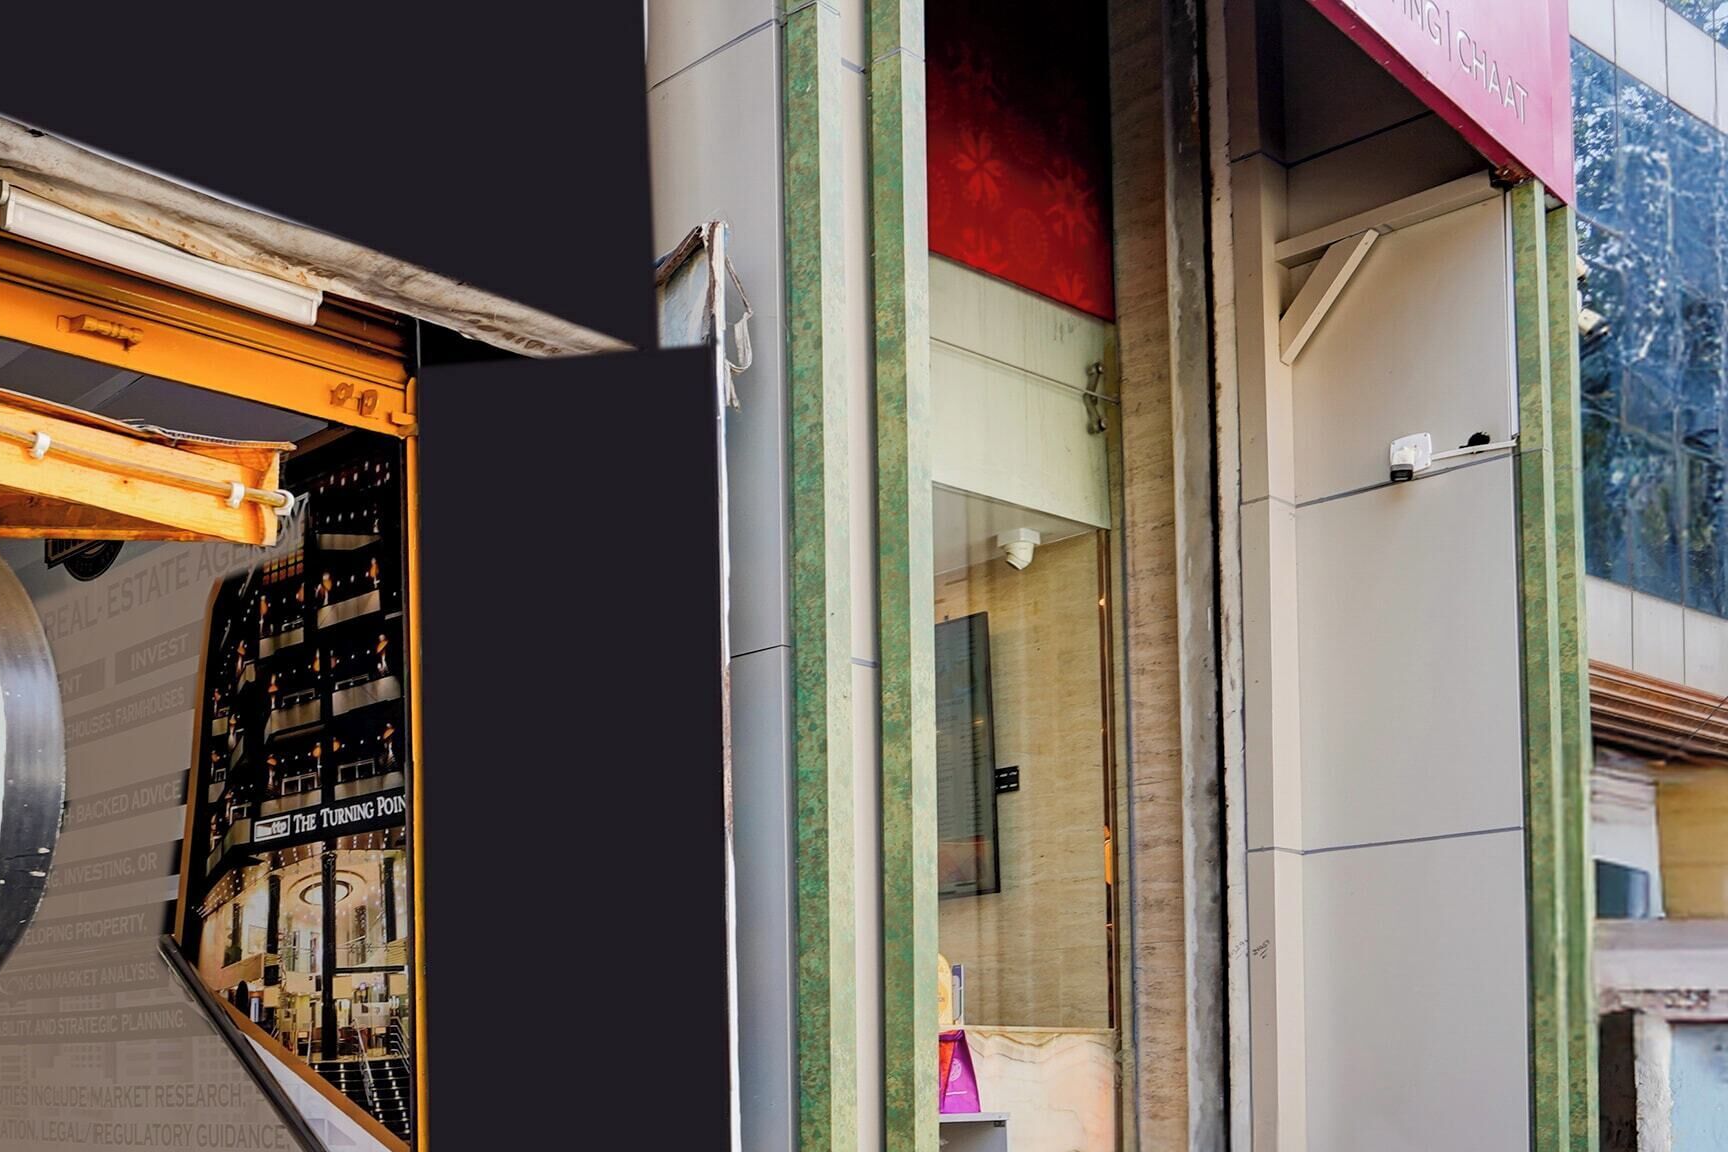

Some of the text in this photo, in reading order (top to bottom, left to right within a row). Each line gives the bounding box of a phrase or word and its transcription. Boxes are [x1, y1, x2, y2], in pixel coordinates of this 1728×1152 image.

[1456, 29, 1529, 125] CHAAT
[131, 633, 189, 671] INVEST
[131, 779, 182, 813] ADVICE
[293, 812, 317, 834] THE
[320, 800, 374, 828] TURNING
[138, 852, 157, 872] OR
[57, 1013, 119, 1035] STRATEGIC
[31, 1085, 87, 1107] INCLUDE
